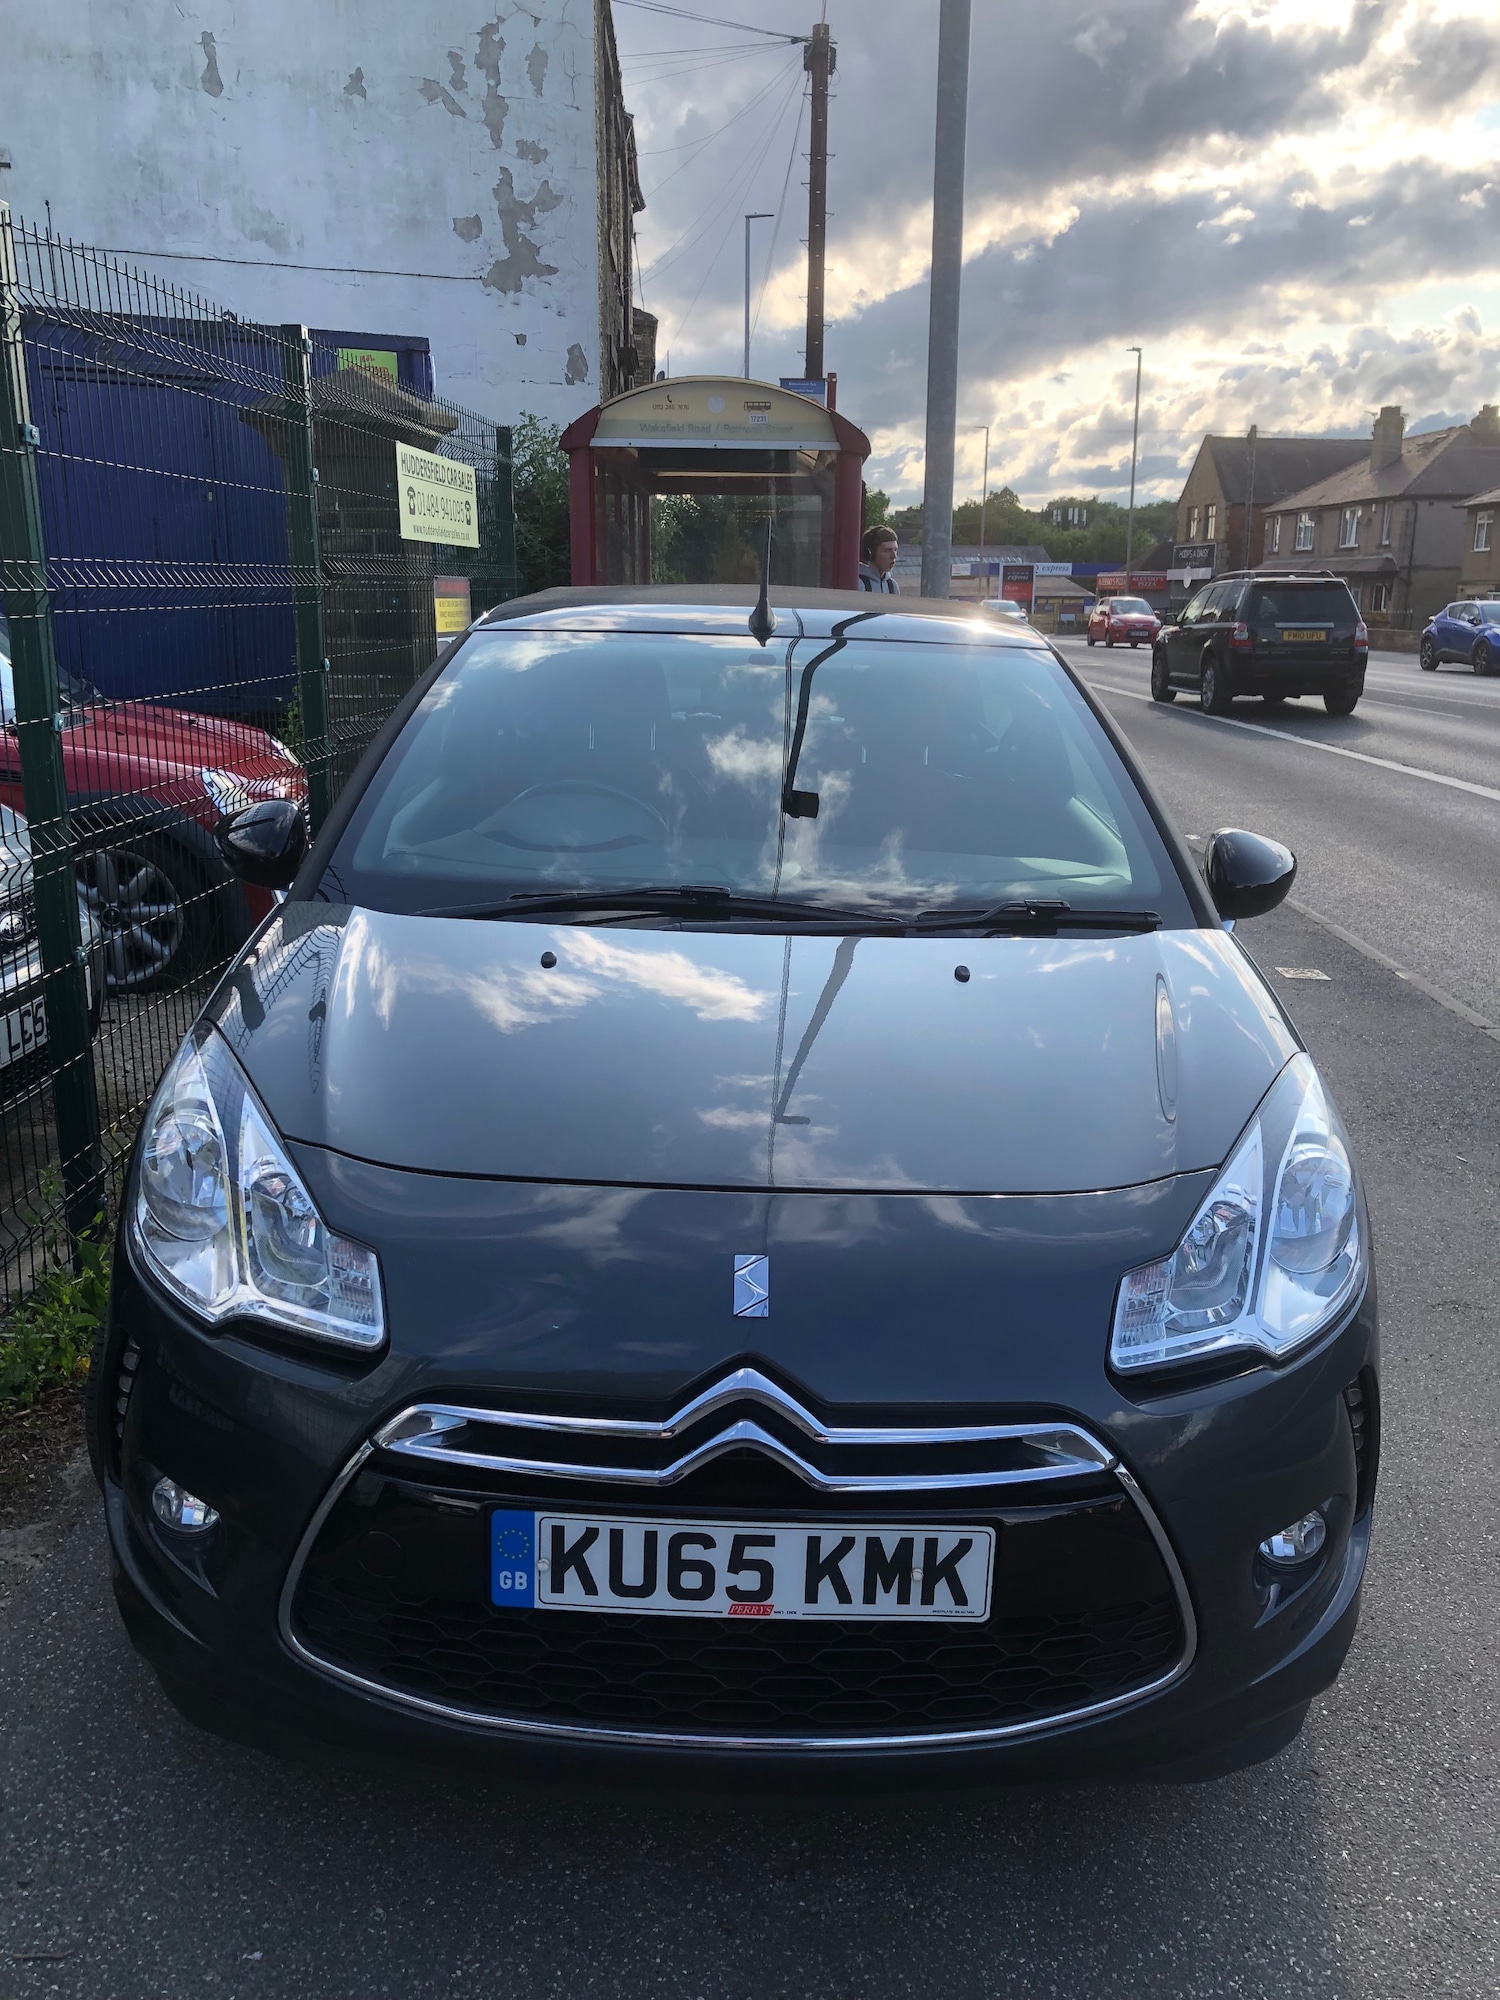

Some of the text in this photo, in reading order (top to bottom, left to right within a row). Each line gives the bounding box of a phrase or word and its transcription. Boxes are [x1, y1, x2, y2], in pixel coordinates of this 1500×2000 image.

[639, 423, 685, 433] Wakefield
[688, 423, 711, 433] Road
[766, 424, 793, 434] Street
[400, 451, 473, 492] HUDDERSFIELD CAR SALES
[417, 490, 439, 518] 01484
[1041, 563, 1069, 573] express
[1007, 574, 1029, 582] express
[549, 1525, 974, 1606] KU65 KMK
[499, 1571, 528, 1591] GB
[730, 1605, 773, 1614] PERRYS
